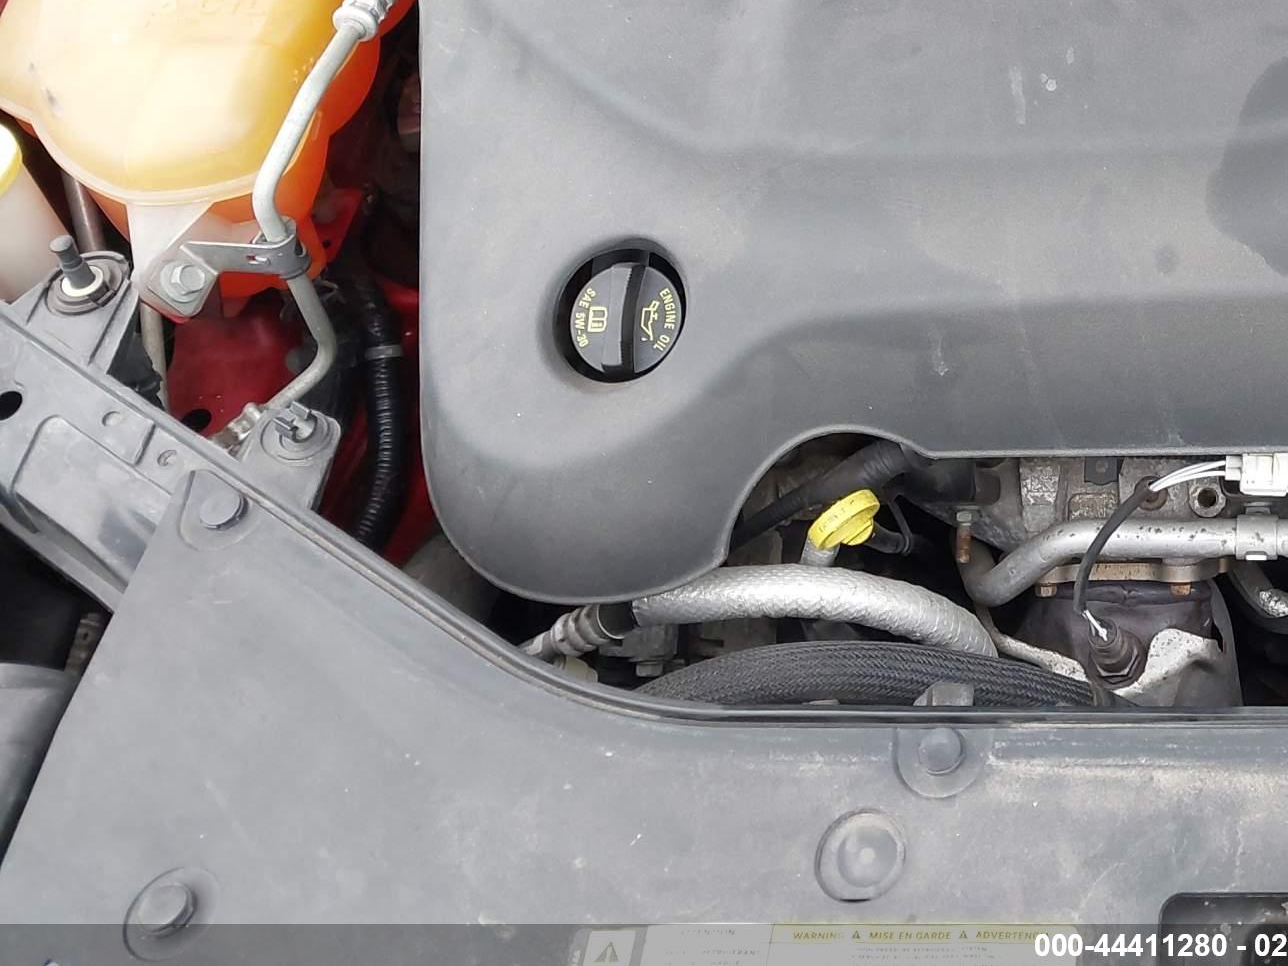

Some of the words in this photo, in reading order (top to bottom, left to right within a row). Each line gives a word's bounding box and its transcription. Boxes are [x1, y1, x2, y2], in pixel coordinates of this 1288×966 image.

[578, 288, 597, 309] SAE
[659, 287, 676, 331] ENGINE
[653, 334, 670, 352] OIL
[869, 931, 894, 940] MISE
[898, 931, 912, 940] EN
[915, 931, 952, 940] GARDE
